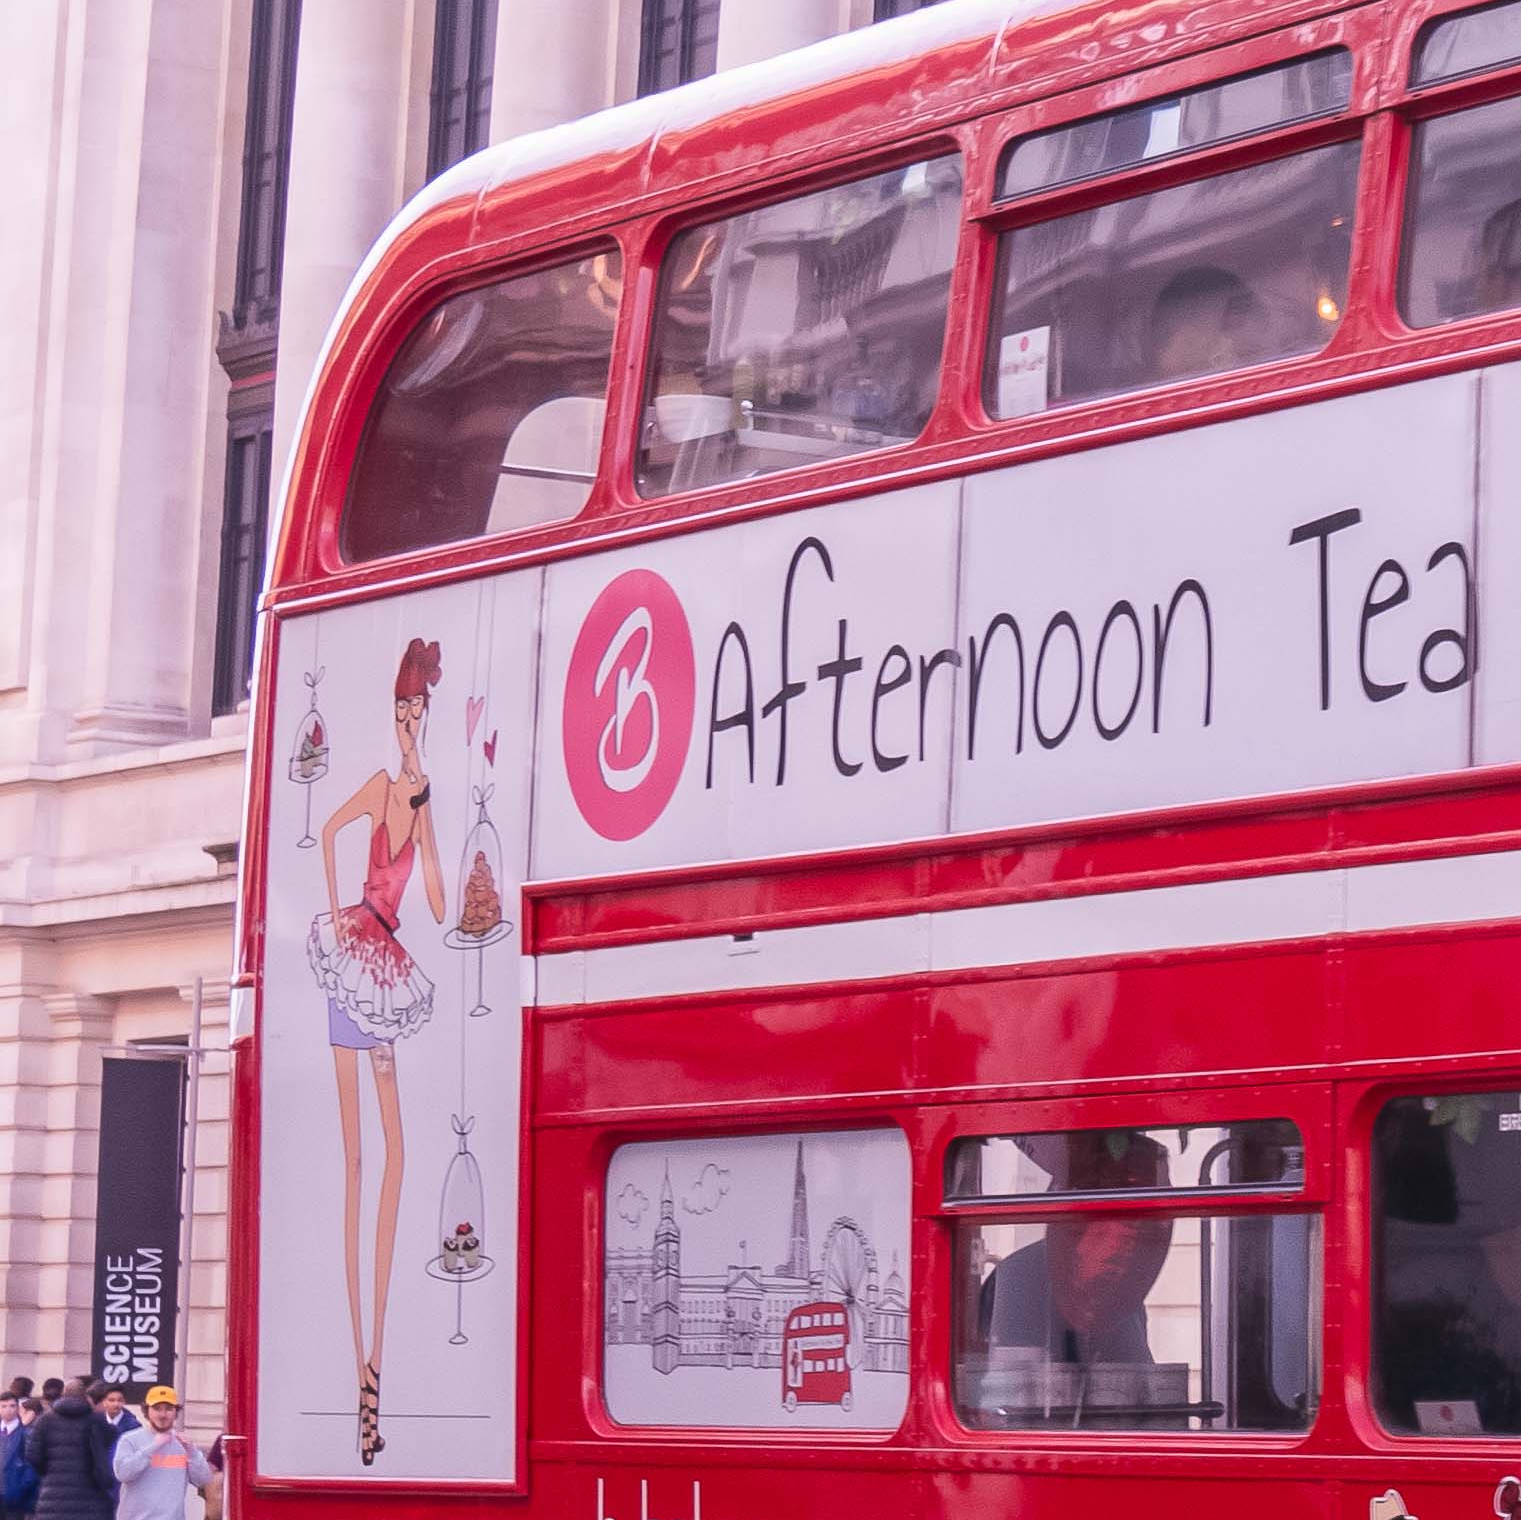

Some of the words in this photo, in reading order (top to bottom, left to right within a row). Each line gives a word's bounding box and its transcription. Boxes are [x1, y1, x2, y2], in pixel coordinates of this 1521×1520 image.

[705, 536, 1214, 789] Afternoon
[1289, 507, 1479, 711] Tea
[103, 1254, 134, 1384] SCIENCE
[132, 1247, 163, 1384] MUSEUM
